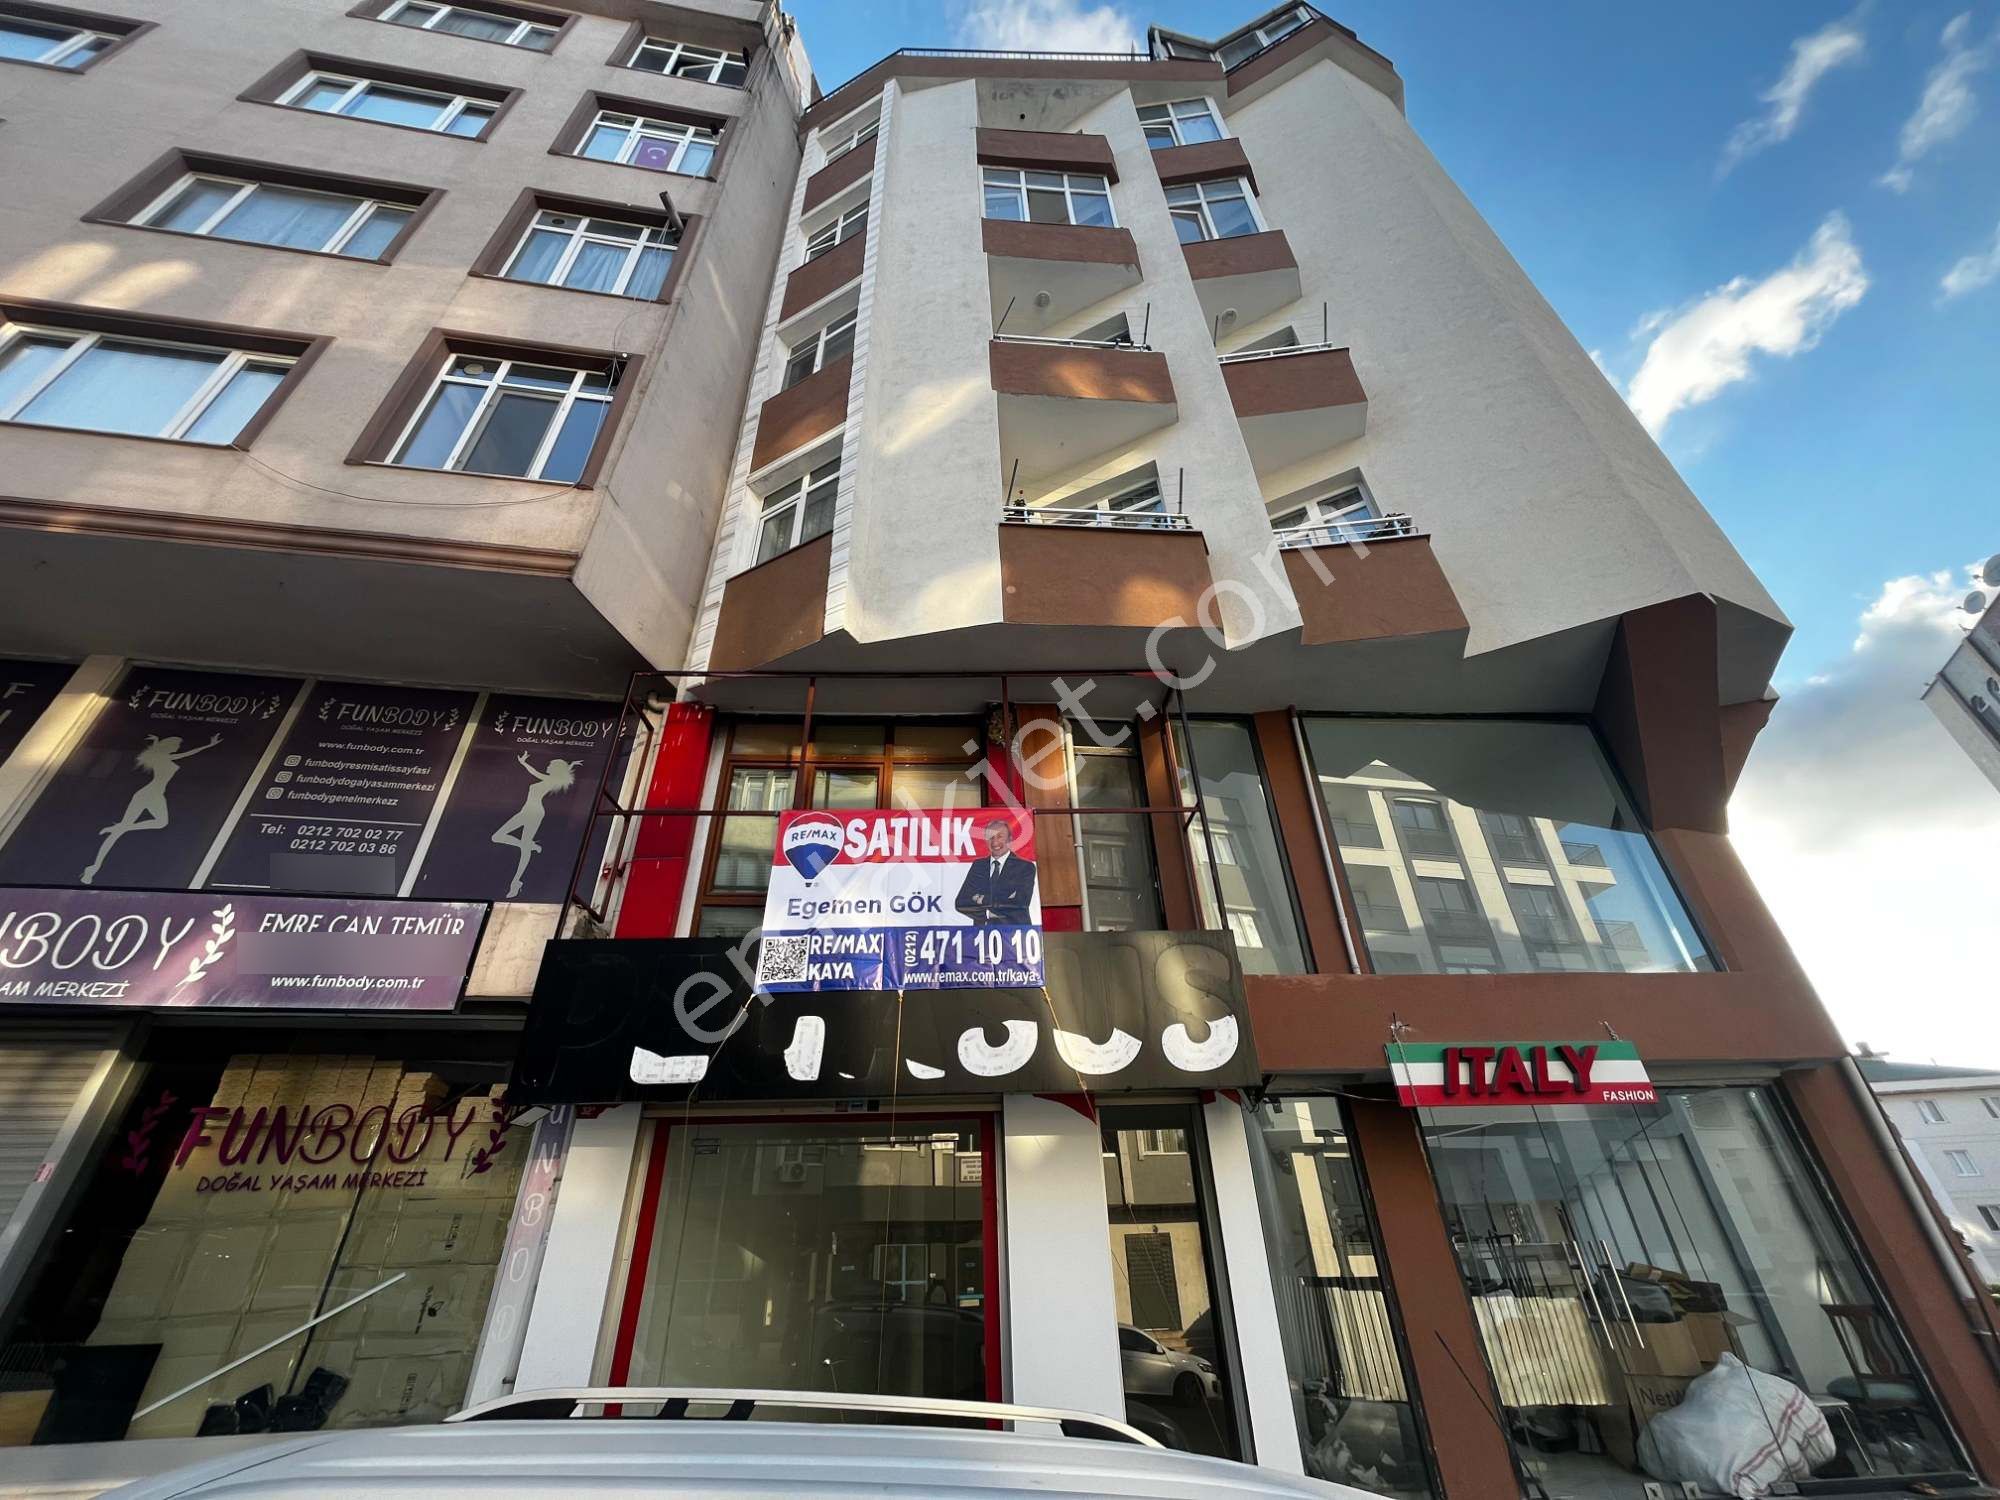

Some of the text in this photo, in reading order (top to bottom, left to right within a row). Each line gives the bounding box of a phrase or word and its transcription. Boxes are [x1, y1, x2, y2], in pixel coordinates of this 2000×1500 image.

[148, 690, 265, 715] FUNBODY
[337, 702, 445, 727] FUNBODY
[512, 715, 613, 738] FUNBODY
[319, 741, 425, 755] www.funbody.com.tr
[260, 823, 405, 841] Tel: 0212 702 02 77
[791, 829, 837, 842] RE/MAX
[844, 817, 977, 859] SATILIK
[290, 838, 398, 855] 0212 702 03 86
[787, 891, 943, 920] Egemen GÖK
[810, 934, 881, 955] RE/MAX
[904, 928, 1041, 967] (0212) 471 10 10
[808, 962, 854, 980] KAYA
[904, 968, 1037, 985] www.remax.com.tr/kaya
[33, 980, 130, 998] MERKEZİ
[271, 974, 425, 990] www.funbody.com.tr
[1442, 1044, 1599, 1095] ITALY
[1603, 1089, 1654, 1102] FASHION
[175, 1103, 476, 1168] FUNBODY
[196, 1168, 429, 1194] DOĞAL YAŞAM MERKEZİ
